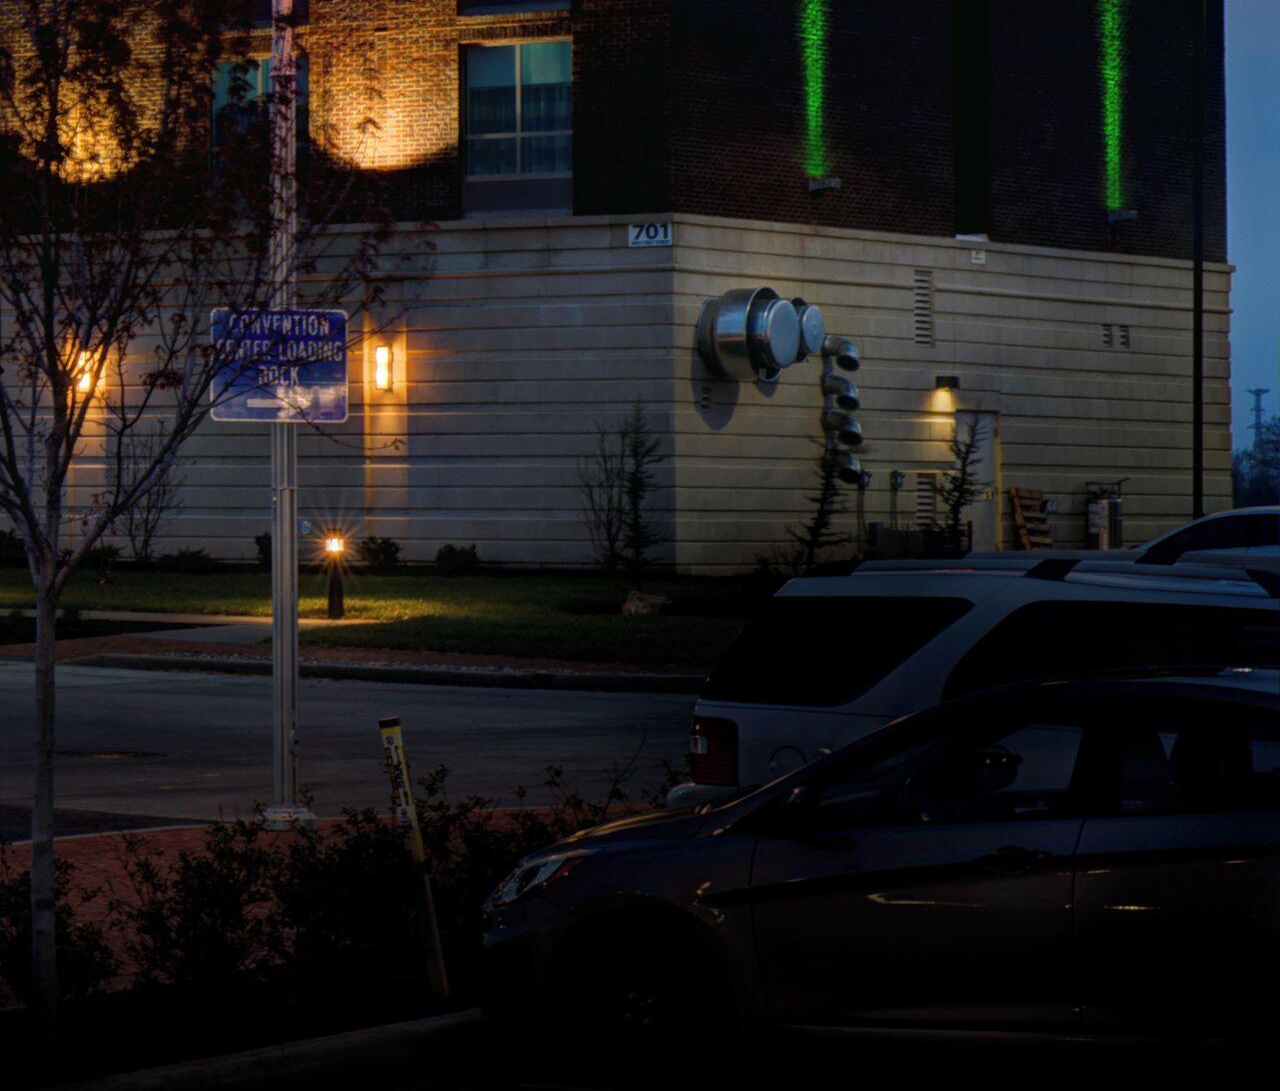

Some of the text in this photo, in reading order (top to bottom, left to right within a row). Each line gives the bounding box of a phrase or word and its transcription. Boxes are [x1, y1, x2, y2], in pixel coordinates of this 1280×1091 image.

[632, 223, 668, 240] 701
[228, 314, 330, 336] CONVENTION
[278, 340, 343, 362] LOADING
[258, 365, 301, 387] DOCK
